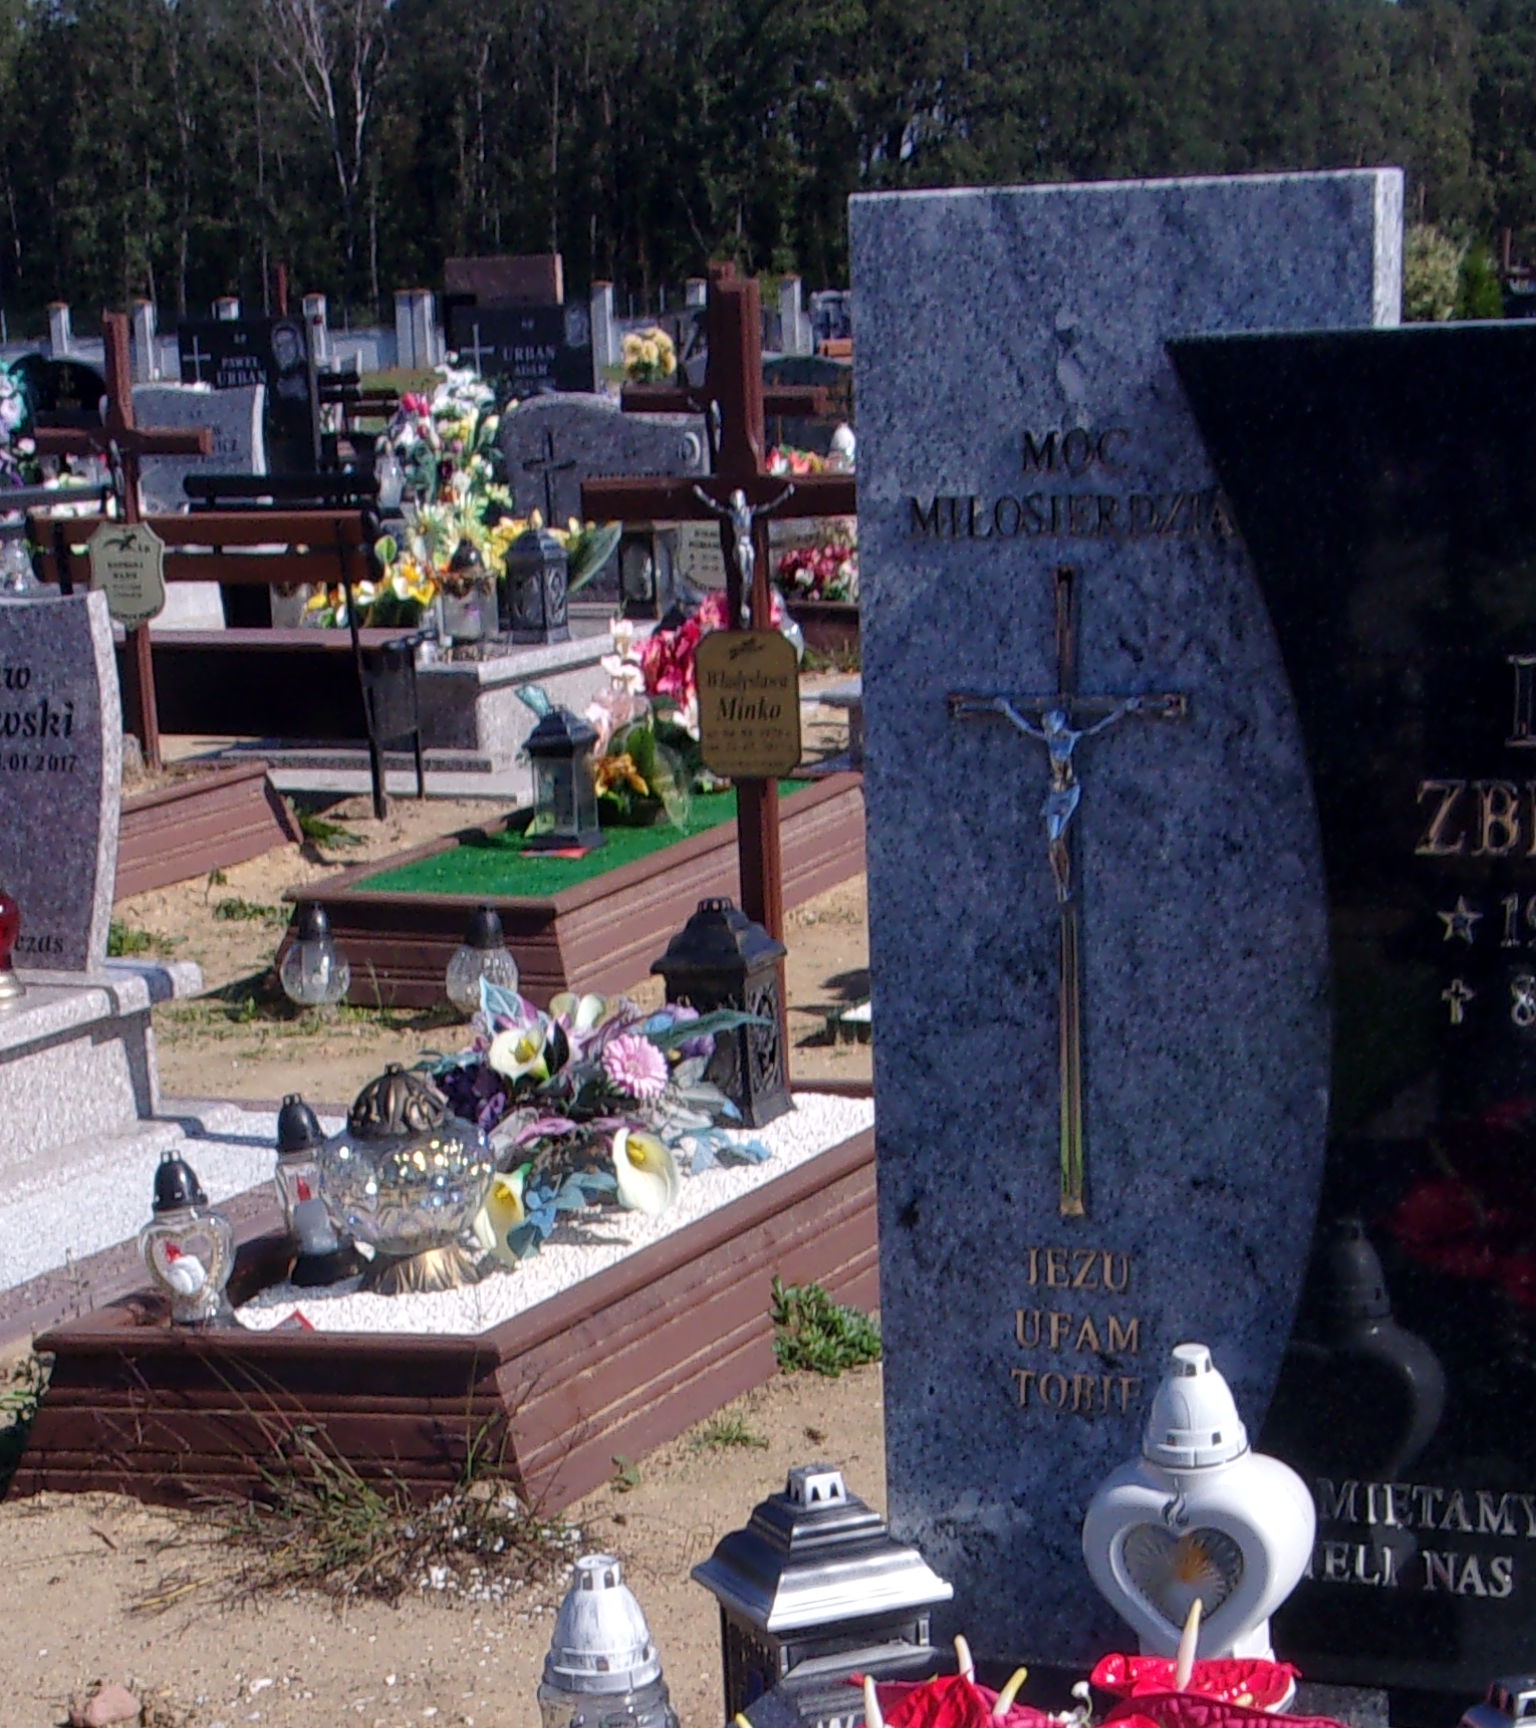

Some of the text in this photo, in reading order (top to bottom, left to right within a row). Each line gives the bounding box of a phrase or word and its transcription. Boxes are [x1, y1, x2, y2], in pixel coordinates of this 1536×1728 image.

[1021, 426, 1130, 477] MOC
[1025, 1245, 1132, 1293] JEZU
[1015, 1308, 1142, 1354] UFAM
[1422, 1549, 1514, 1599] NAS
